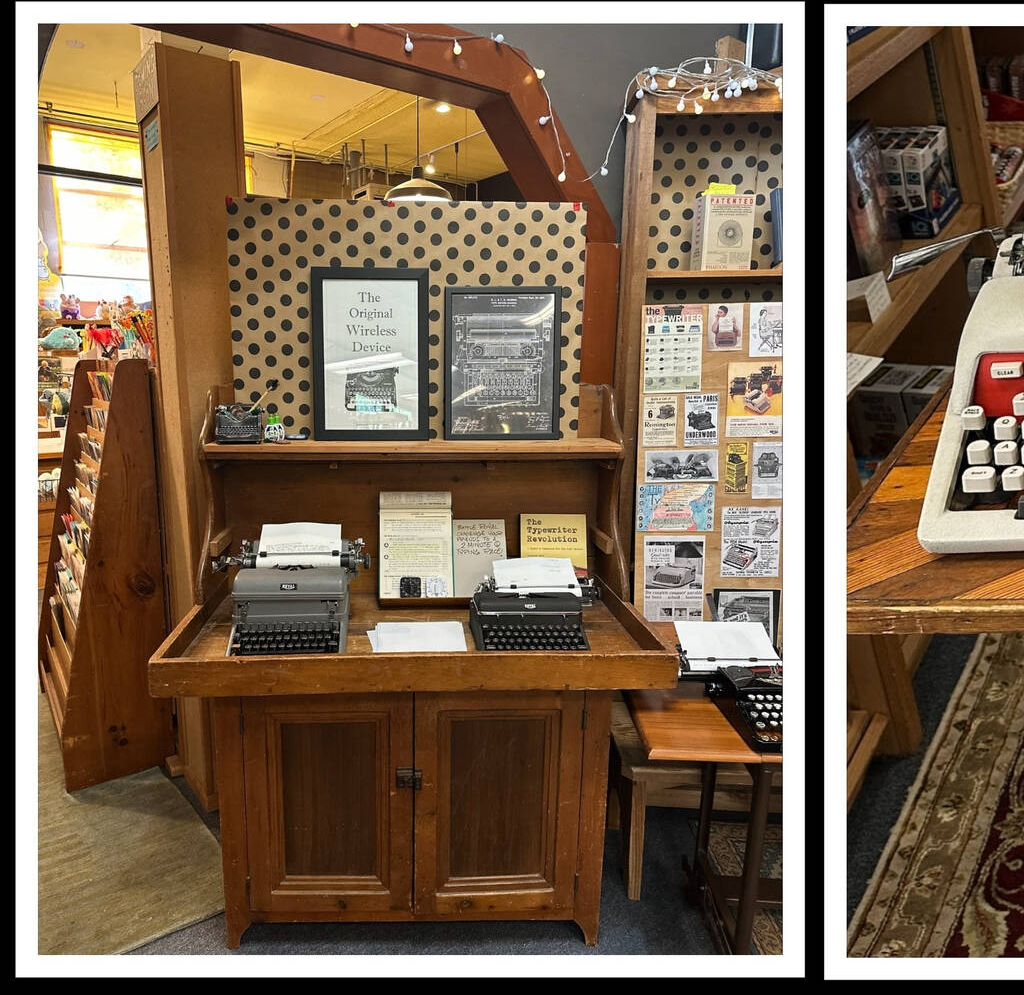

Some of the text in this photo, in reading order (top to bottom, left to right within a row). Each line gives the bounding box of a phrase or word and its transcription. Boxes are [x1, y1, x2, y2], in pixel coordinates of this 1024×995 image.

[710, 197, 754, 205] PATENTED
[358, 291, 381, 303] The
[349, 307, 393, 321] Original
[646, 306, 660, 315] the
[646, 315, 703, 323] TYPEWRITER
[346, 324, 397, 337] Wireless
[352, 341, 391, 353] Device
[648, 410, 653, 418] 6
[685, 431, 716, 439] UNDERWOOD
[527, 526, 578, 536] Typewriter
[527, 535, 578, 543] Revolution
